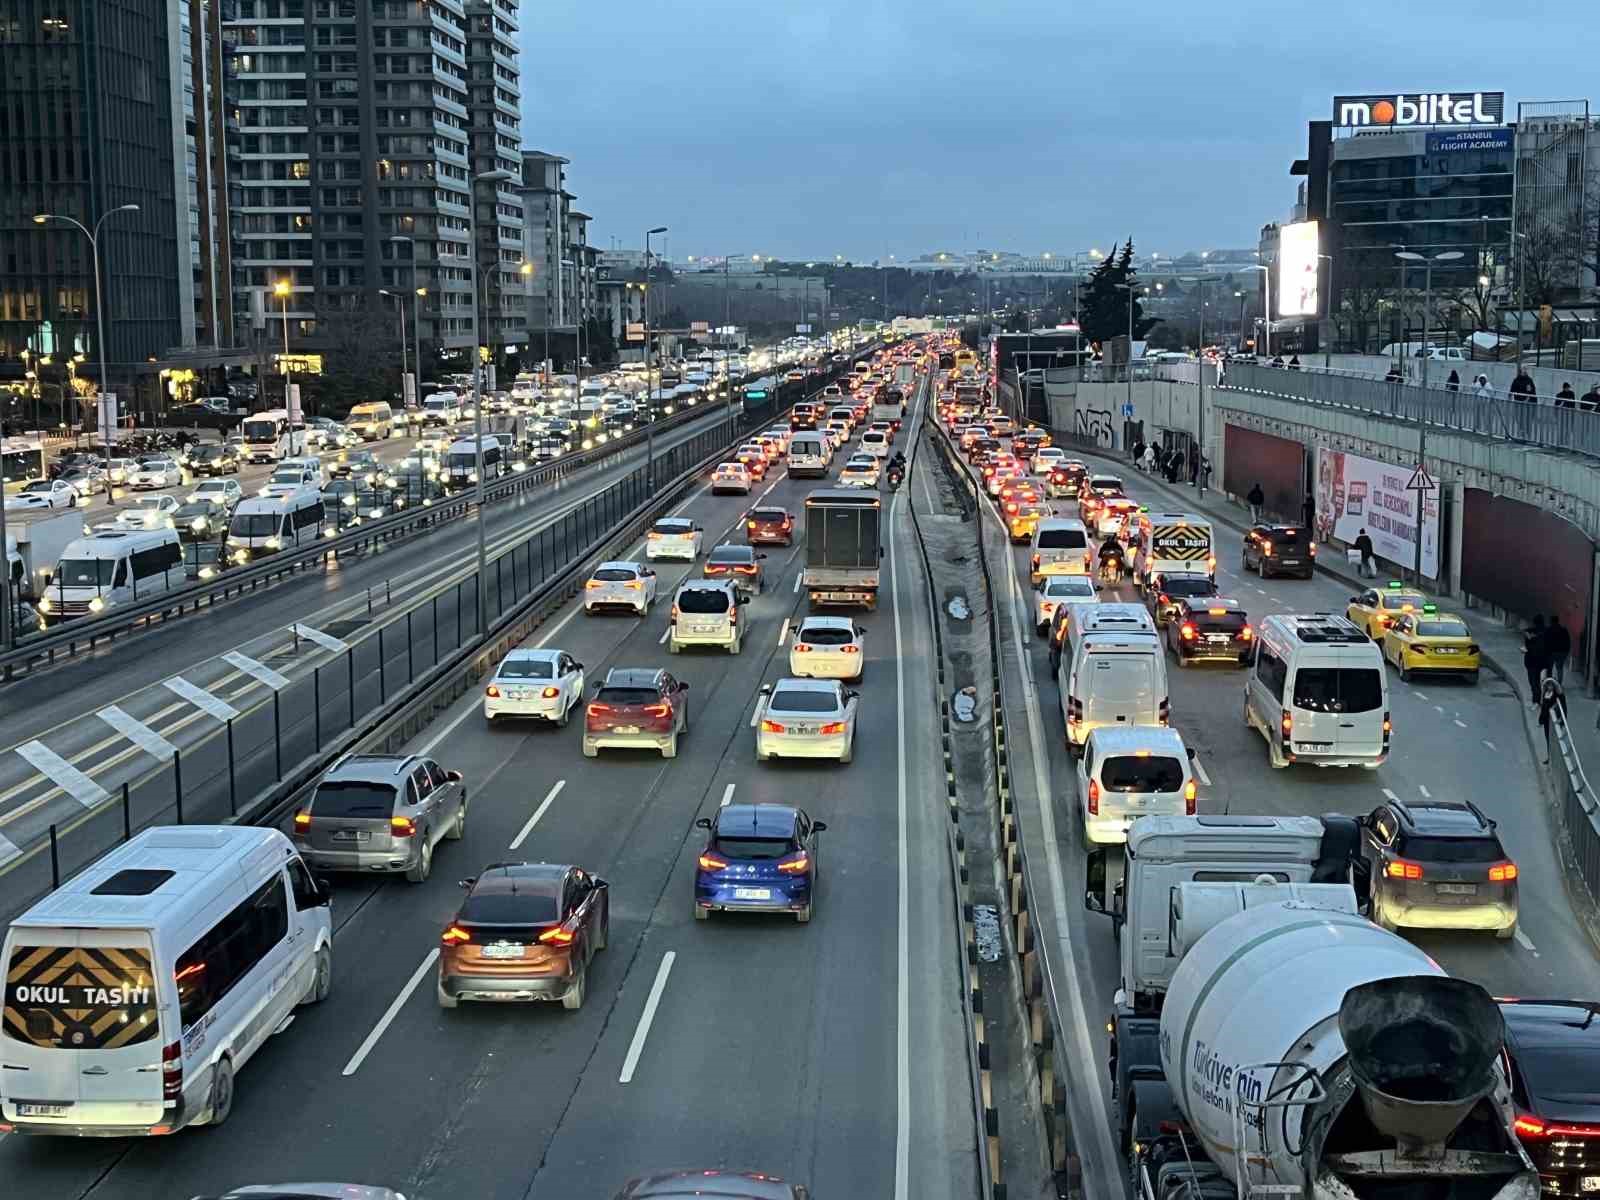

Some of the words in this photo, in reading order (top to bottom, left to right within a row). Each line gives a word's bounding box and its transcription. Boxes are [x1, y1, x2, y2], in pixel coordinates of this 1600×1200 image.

[1440, 142, 1468, 151] FLIGHT
[1469, 140, 1508, 149] ACADEMY
[1159, 538, 1180, 547] OKUL
[15, 985, 70, 1004] OKUL
[83, 986, 149, 1007] TAŞITI
